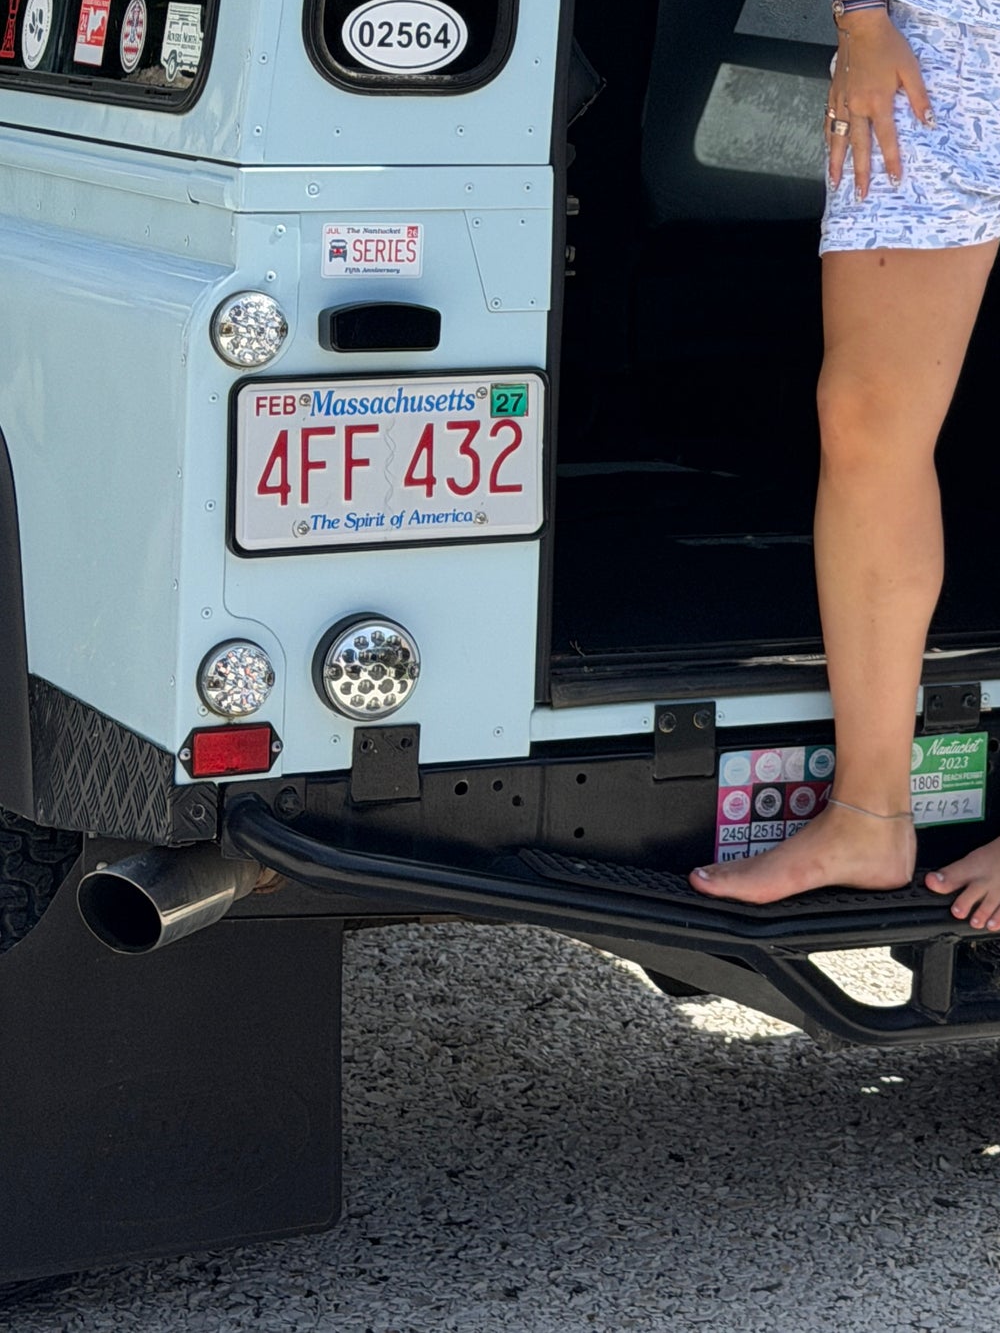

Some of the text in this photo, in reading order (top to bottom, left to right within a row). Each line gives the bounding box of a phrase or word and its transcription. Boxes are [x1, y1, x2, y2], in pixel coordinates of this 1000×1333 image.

[358, 20, 452, 49] 02564
[408, 228, 417, 237] 26
[352, 239, 417, 263] SERIES
[255, 395, 296, 416] FEB
[310, 387, 476, 417] Massachusetts
[495, 393, 524, 414] 27
[257, 419, 523, 506] 4FF 432
[310, 508, 473, 532] The Spirit of America
[926, 737, 984, 756] Nantucket
[938, 756, 969, 770] 2023
[912, 775, 939, 790] 1806
[722, 826, 750, 842] 2450
[753, 823, 784, 838] 2515
